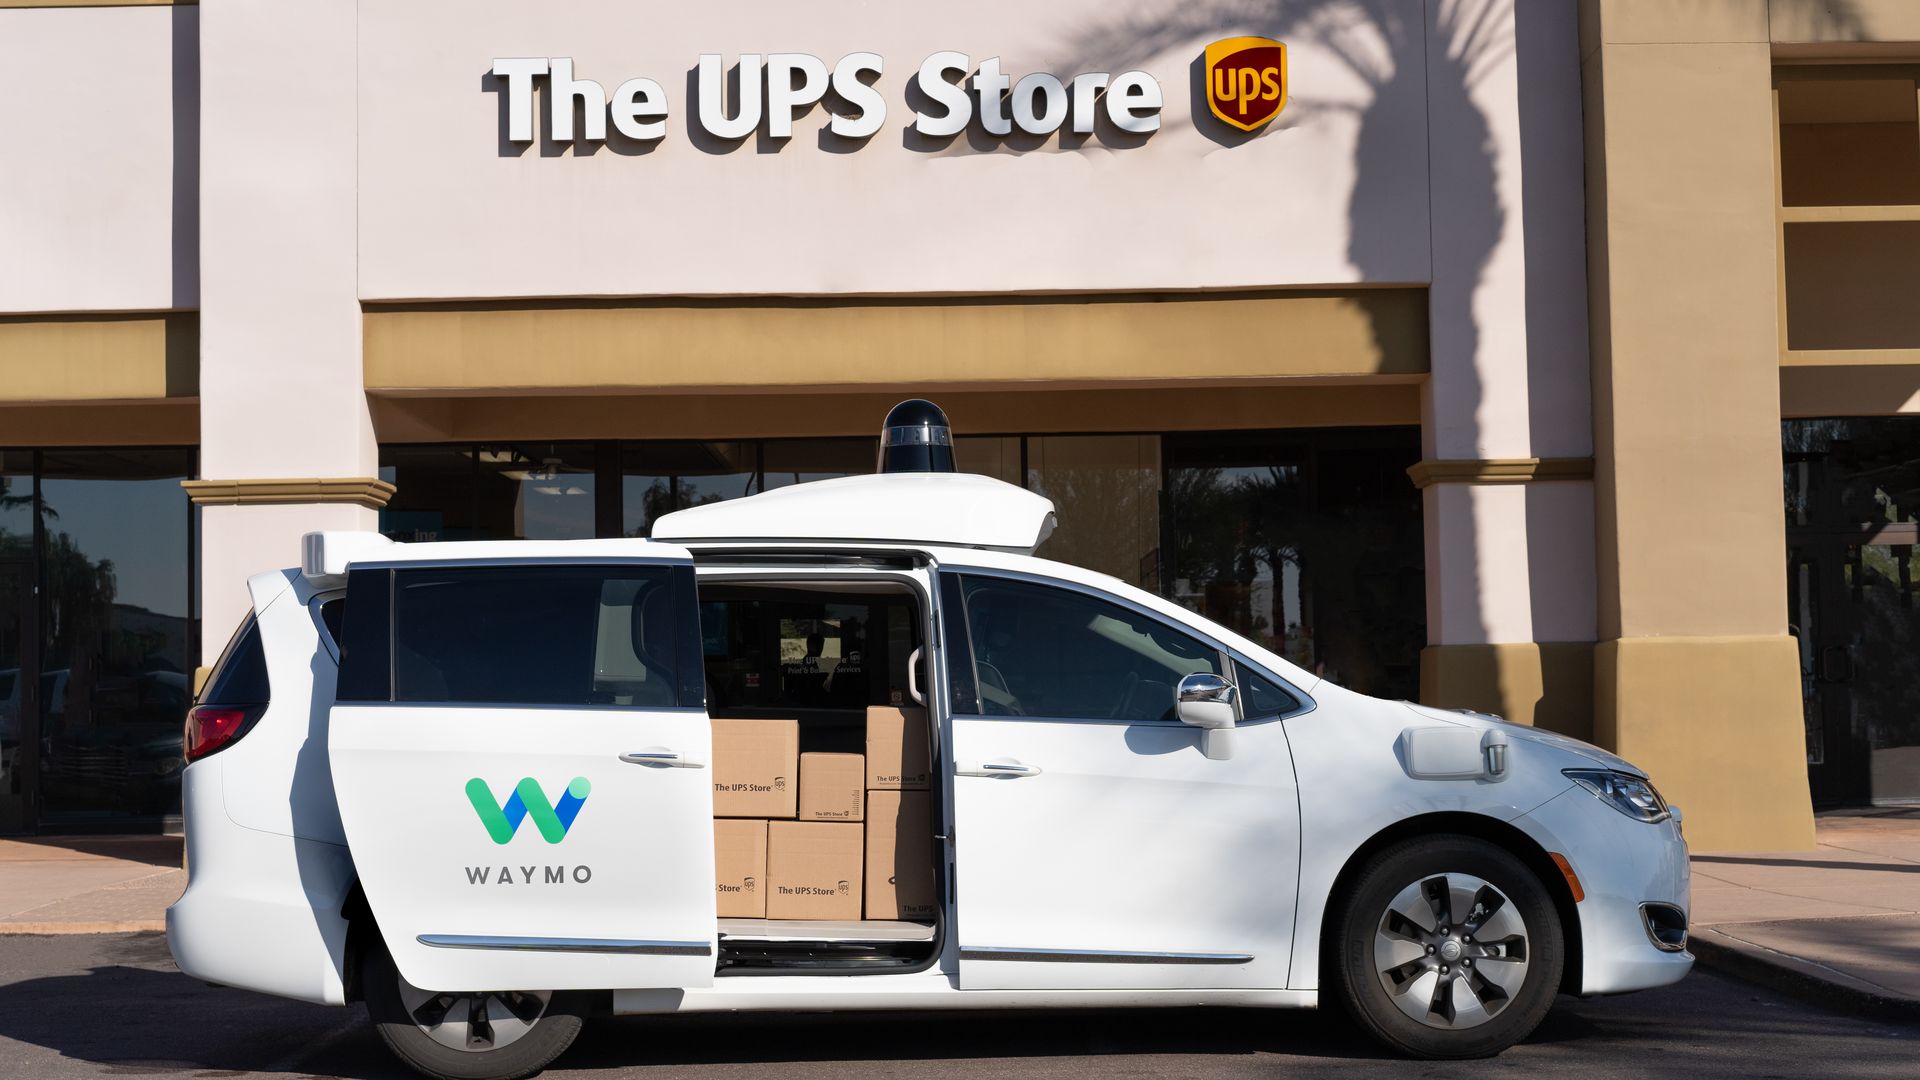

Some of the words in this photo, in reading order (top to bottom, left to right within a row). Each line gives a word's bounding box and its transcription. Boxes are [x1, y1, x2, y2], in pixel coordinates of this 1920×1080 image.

[492, 57, 669, 141] The
[698, 52, 887, 138] UPS
[916, 50, 1163, 136] Store
[1215, 67, 1280, 115] ups
[714, 783, 730, 791] The
[732, 783, 748, 791] UPS
[749, 784, 771, 792] Store
[464, 864, 592, 885] WAYMO
[718, 884, 740, 892] Store
[778, 886, 793, 894] The
[812, 887, 834, 895] Store
